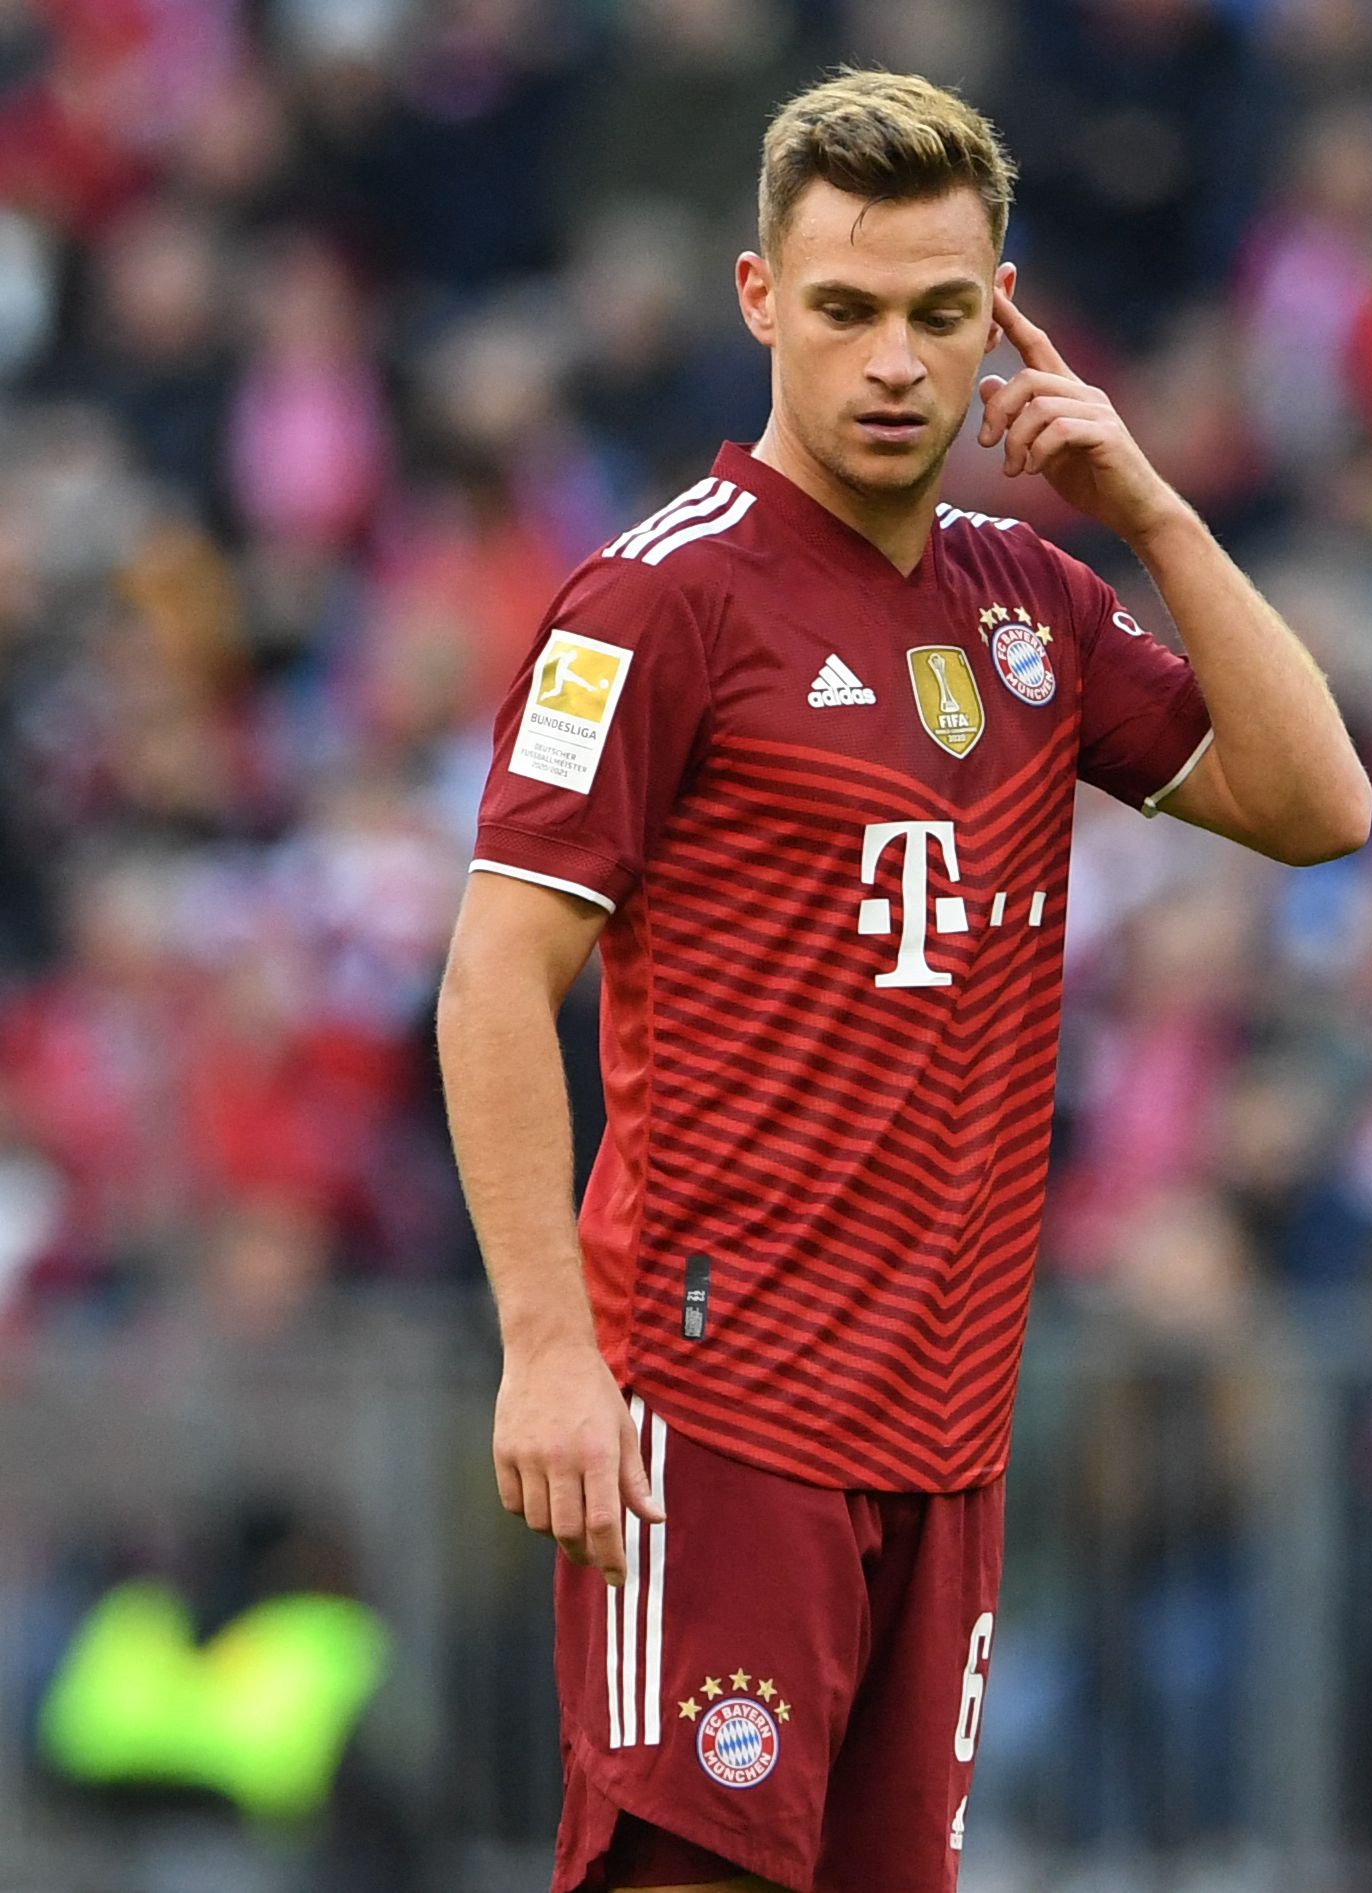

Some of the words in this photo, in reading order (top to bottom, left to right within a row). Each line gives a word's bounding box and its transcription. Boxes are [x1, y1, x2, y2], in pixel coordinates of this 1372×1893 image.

[998, 642, 1007, 660] FC
[1001, 630, 1046, 658] BAYERN
[808, 686, 876, 708] adidas
[530, 712, 597, 740] BUNDESLIGA
[939, 714, 969, 728] FIFA
[534, 743, 576, 760] DEUTSCHER
[955, 1612, 993, 1762] 6
[704, 1715, 721, 1737] FC
[721, 1704, 771, 1738] BAYERN
[704, 1750, 771, 1782] MÜNCHEN
